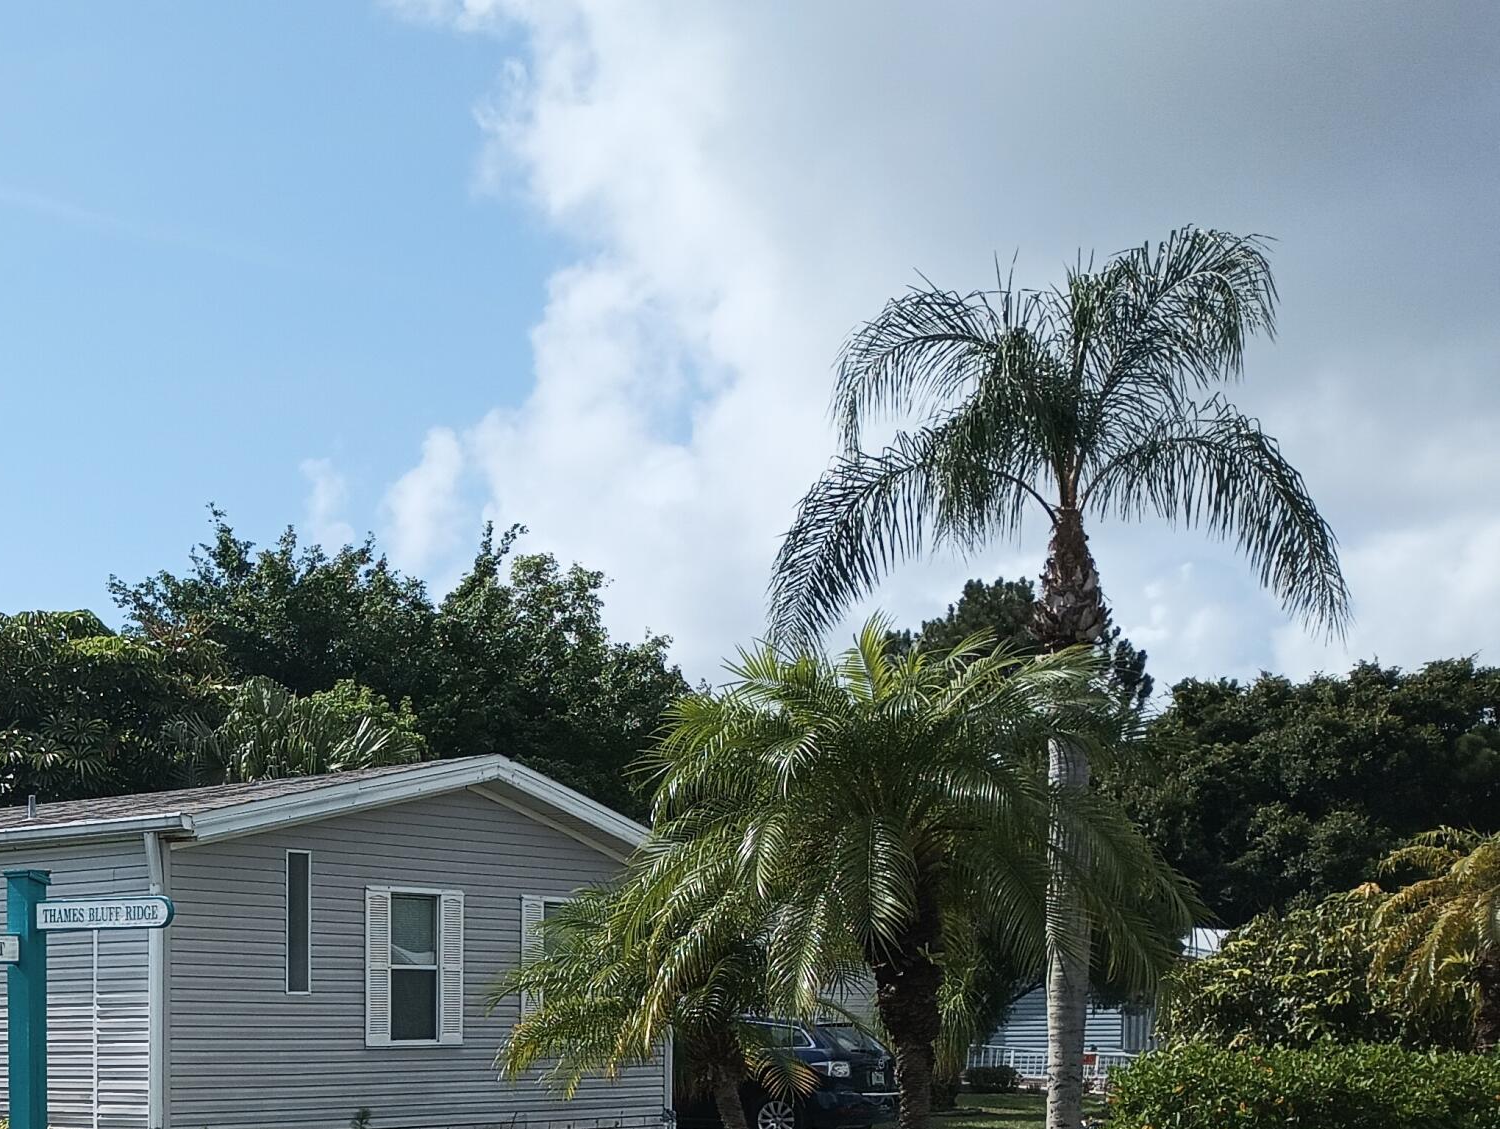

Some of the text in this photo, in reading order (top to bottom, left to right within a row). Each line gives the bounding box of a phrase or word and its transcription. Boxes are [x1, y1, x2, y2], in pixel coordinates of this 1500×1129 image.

[42, 904, 158, 923] THAMES BLUFF RIDGE
